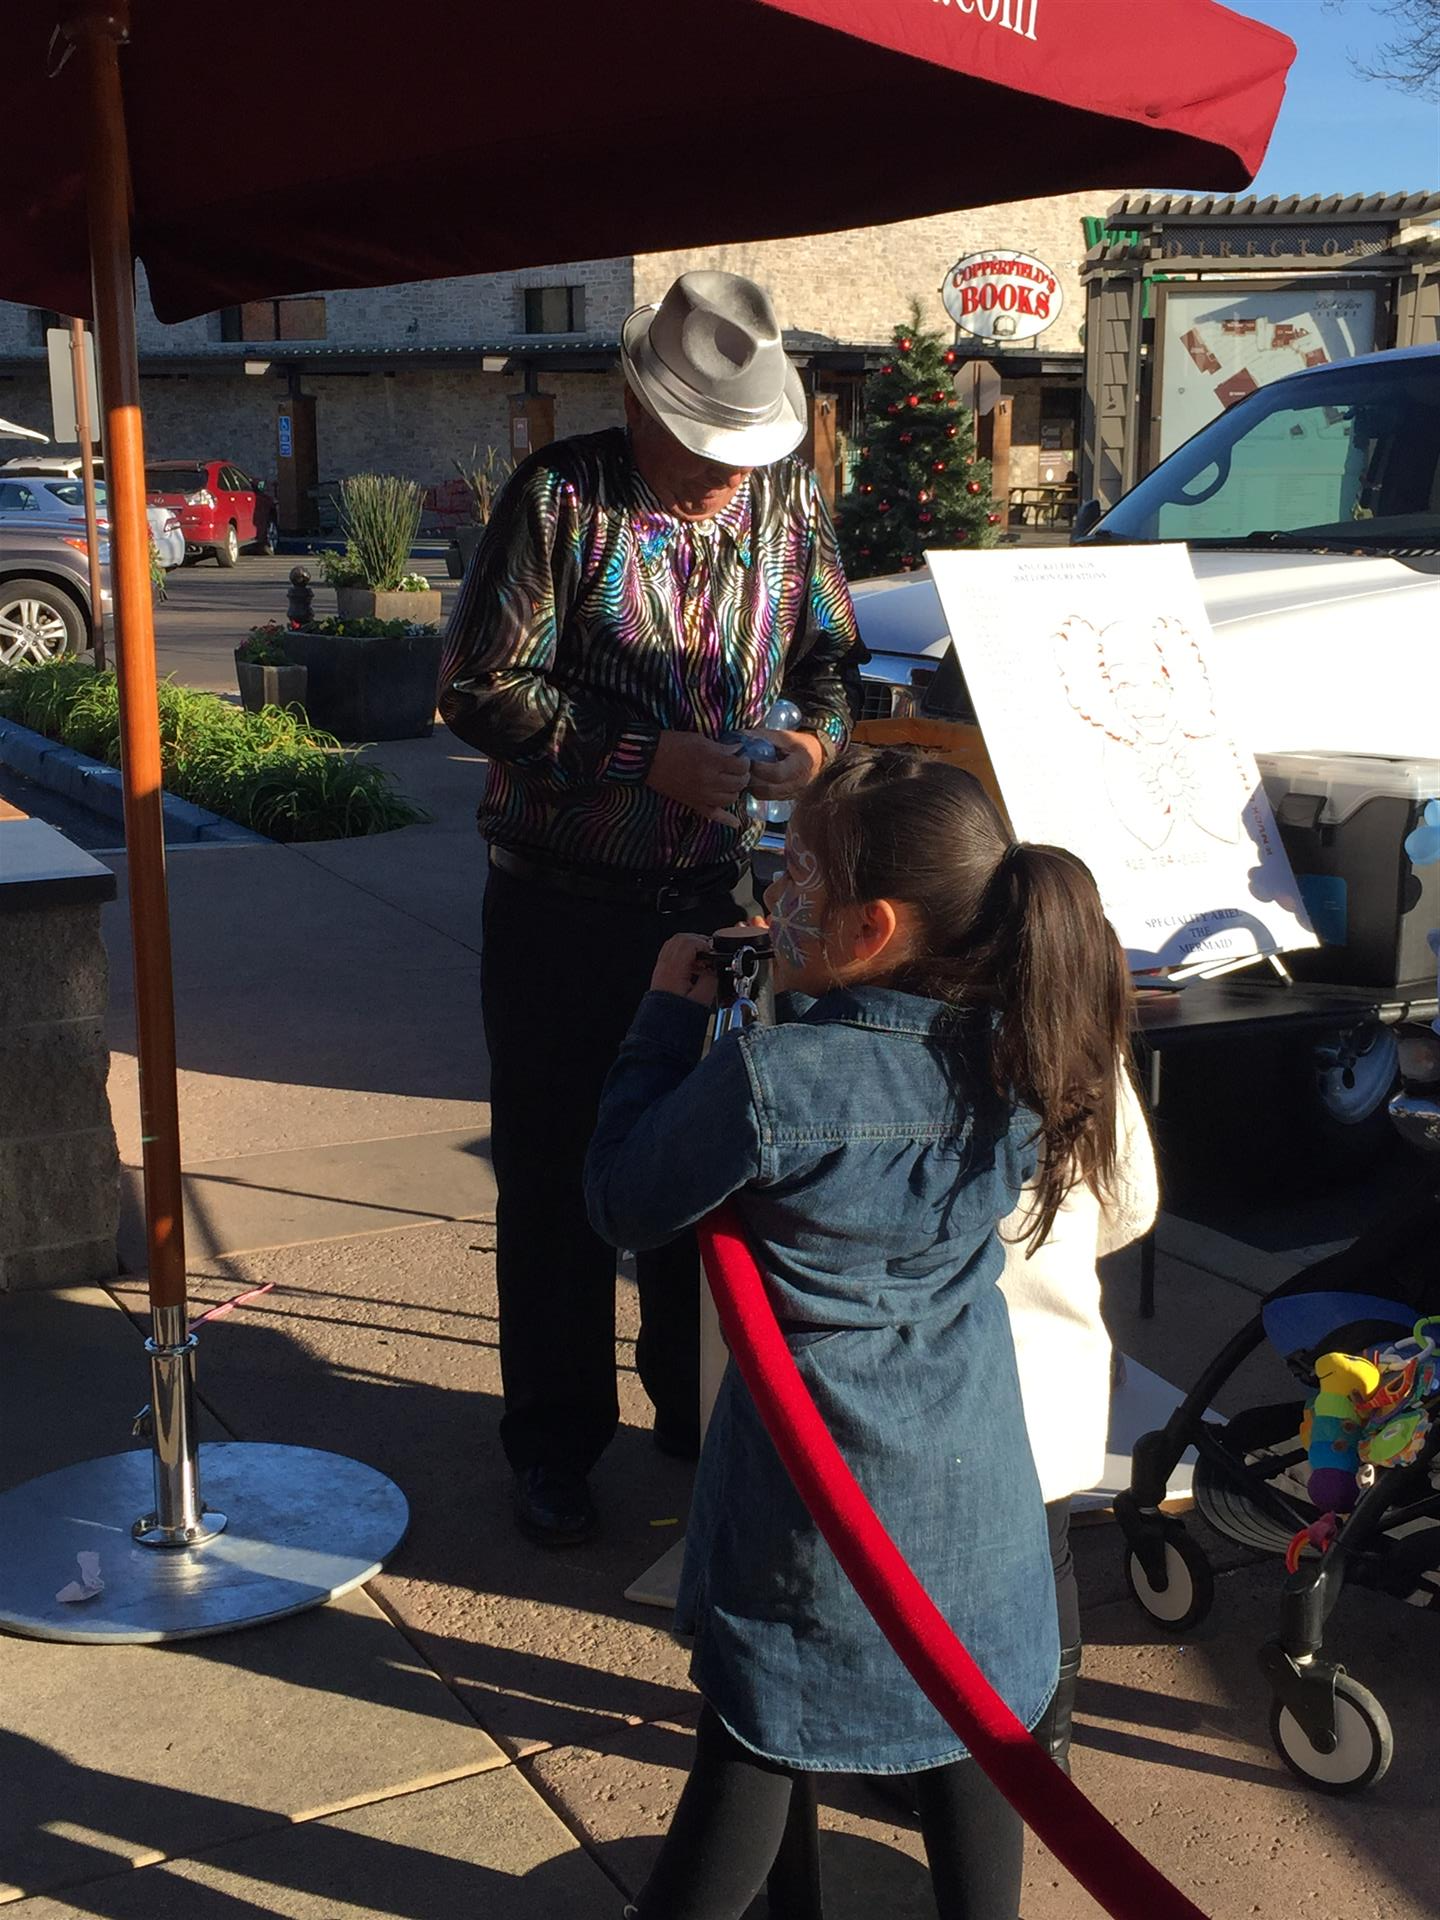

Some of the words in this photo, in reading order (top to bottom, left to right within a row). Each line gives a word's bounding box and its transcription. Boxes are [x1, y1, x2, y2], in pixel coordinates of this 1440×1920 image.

[952, 260, 1056, 294] COPPERFIELD'S
[959, 282, 1050, 319] BOOKS
[1188, 927, 1214, 938] THE
[1177, 938, 1233, 955] MERMAID
